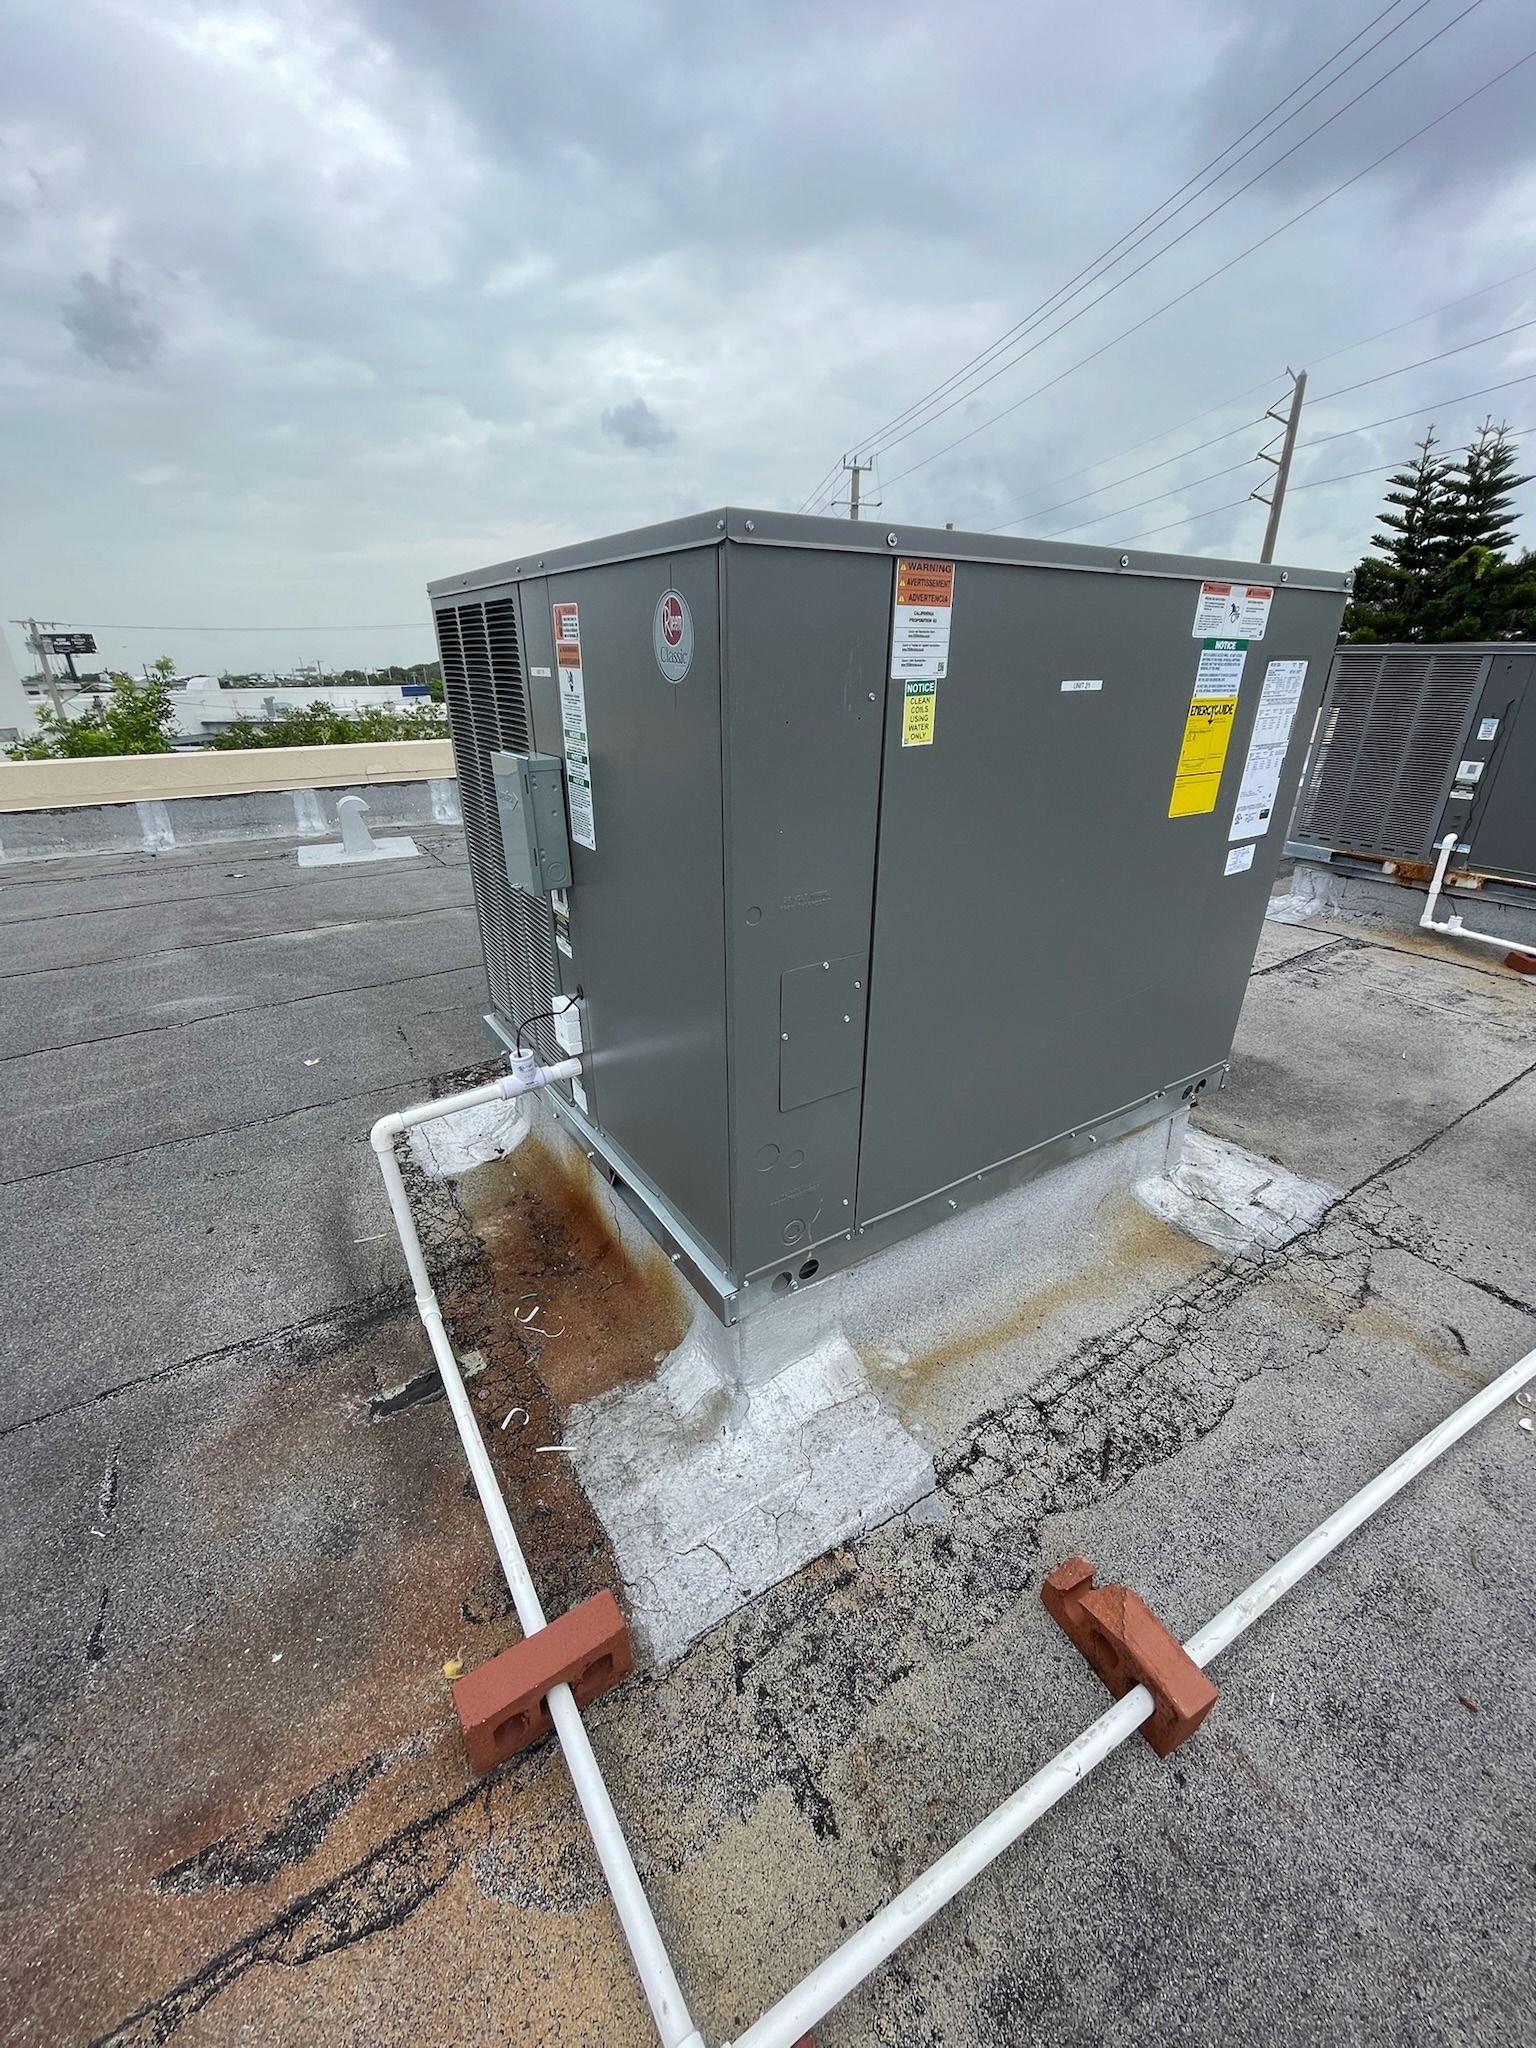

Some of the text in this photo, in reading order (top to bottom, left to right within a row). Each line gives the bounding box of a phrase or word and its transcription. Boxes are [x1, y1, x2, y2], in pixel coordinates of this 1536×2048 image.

[908, 562, 952, 573] WARNING
[907, 578, 951, 588] AVERTISSEMENT
[908, 593, 948, 603] ADVERTENCIA
[1214, 640, 1237, 650] NOTICE
[660, 646, 688, 664] Classic
[906, 683, 935, 693] NOTICE
[910, 697, 931, 705] CLEAN
[910, 705, 929, 714] COILS
[910, 714, 929, 723] USING
[908, 723, 930, 732] WATER
[910, 731, 927, 740] ONLY
